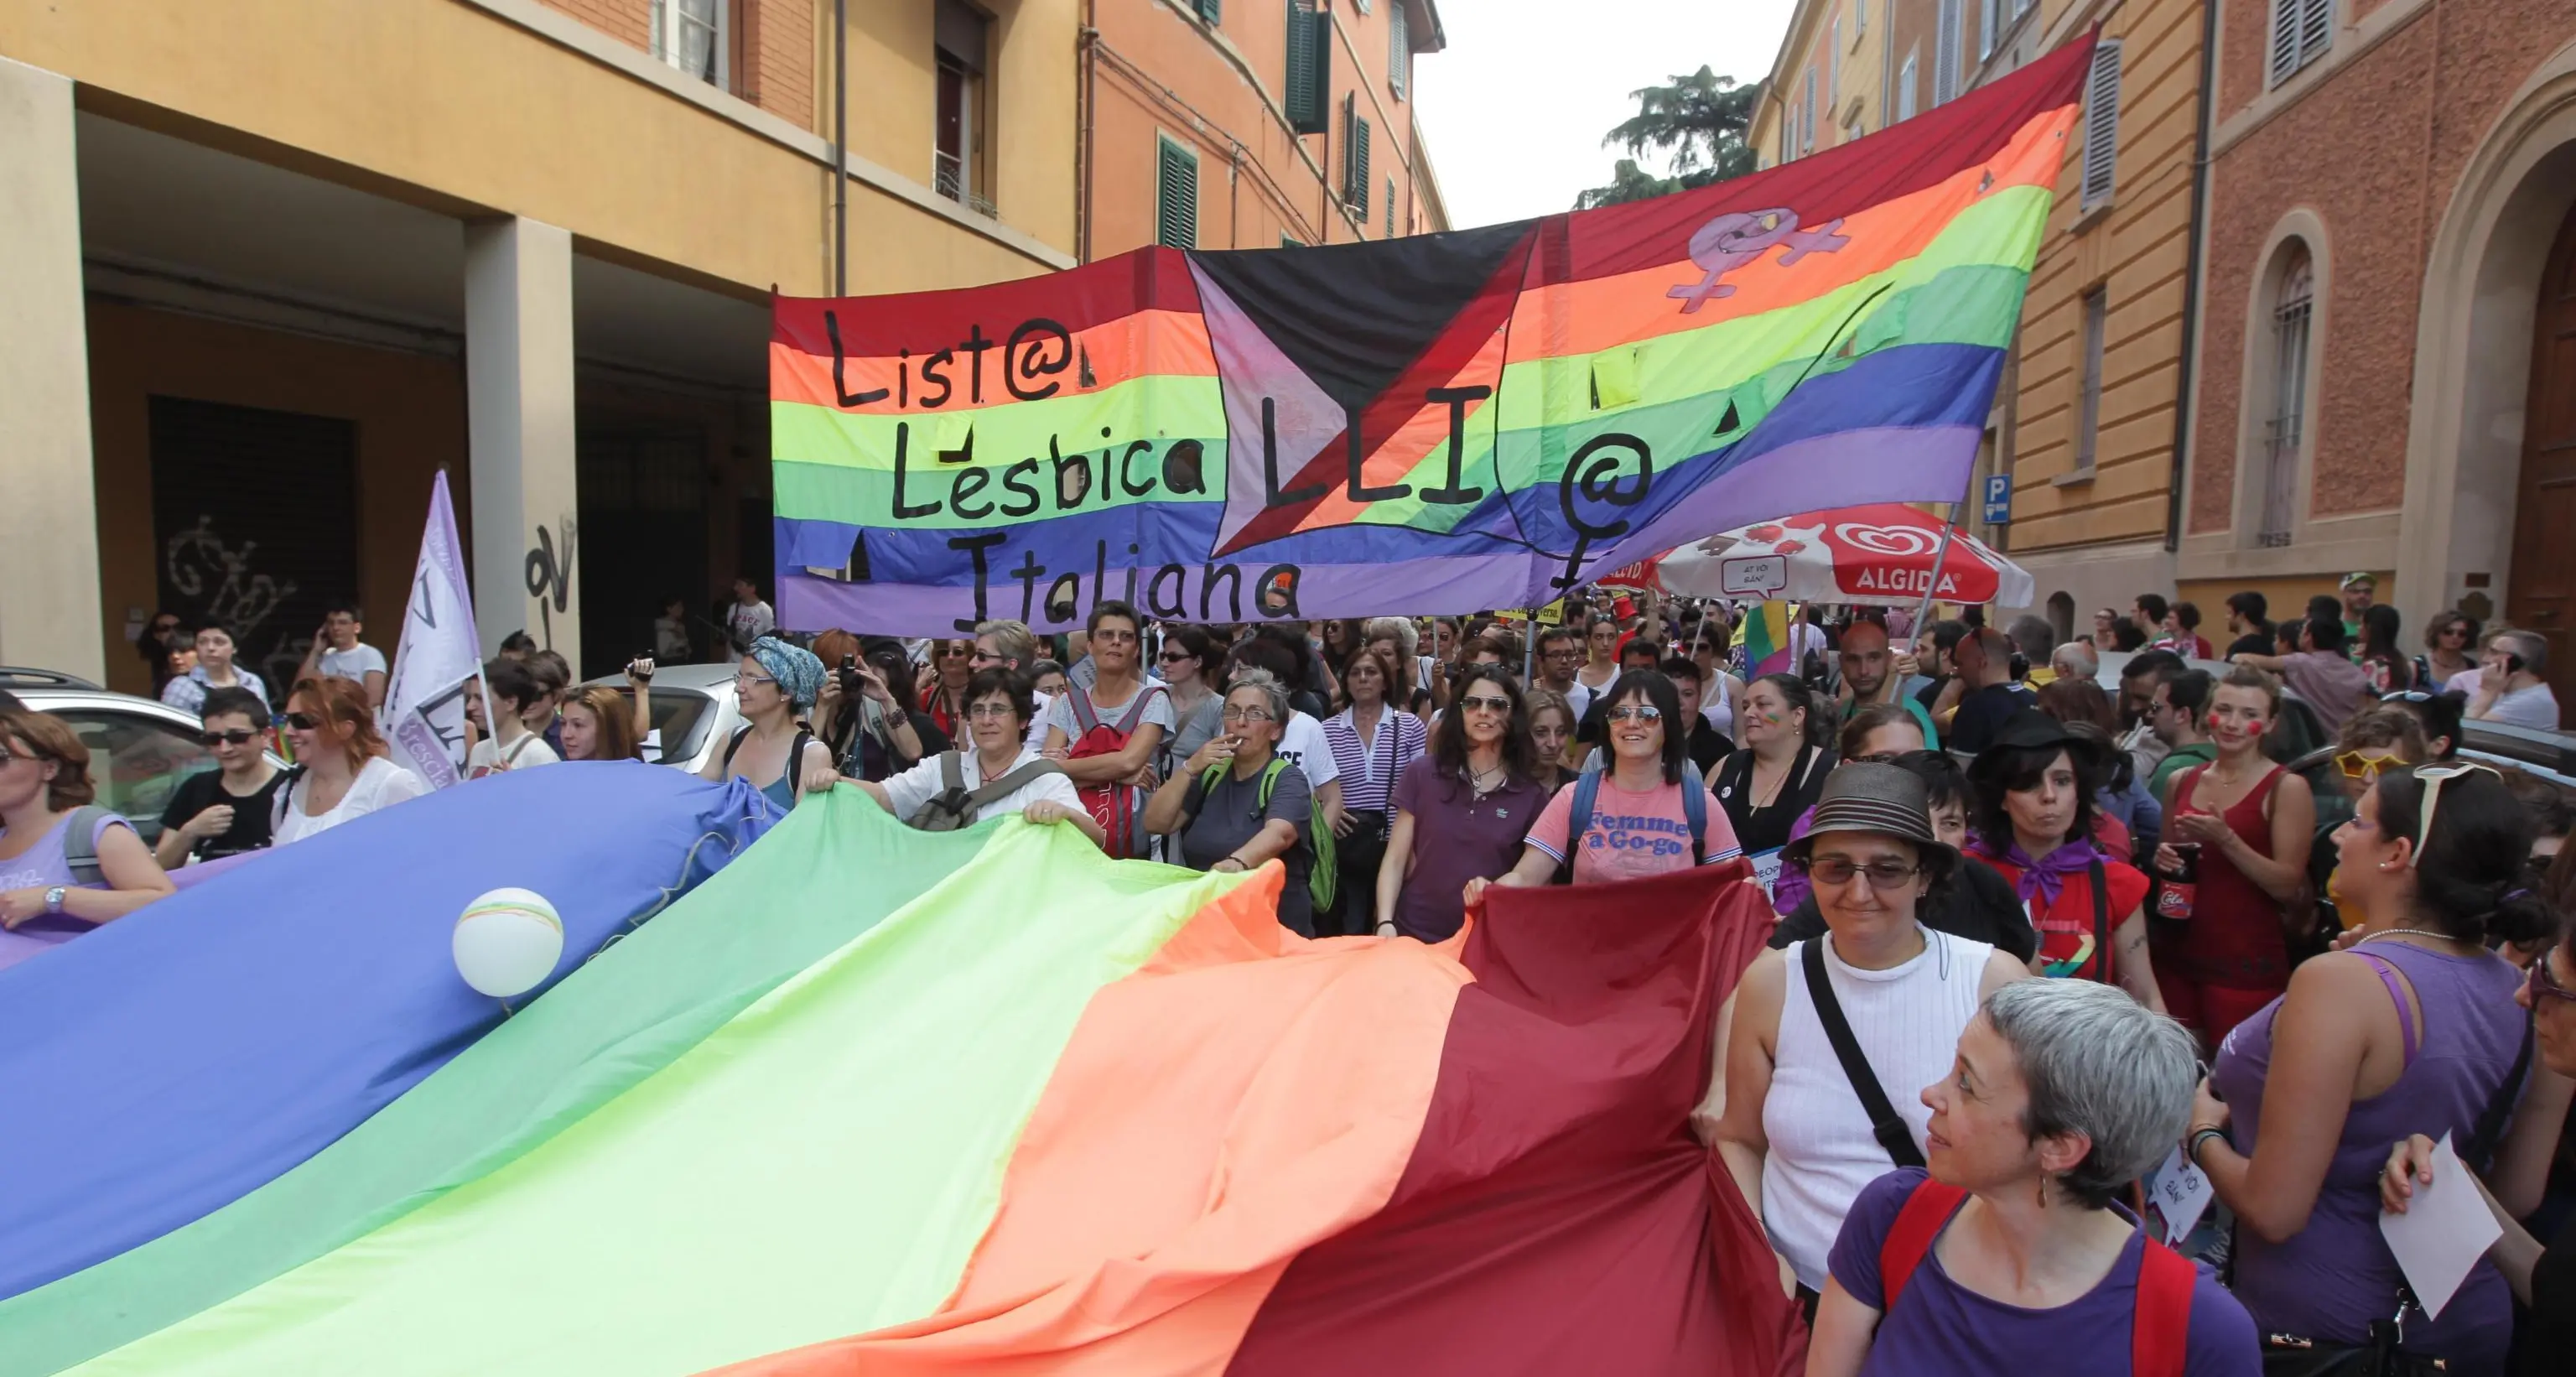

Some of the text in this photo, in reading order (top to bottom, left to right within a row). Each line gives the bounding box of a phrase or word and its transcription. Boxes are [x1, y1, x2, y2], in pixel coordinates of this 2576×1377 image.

[823, 310, 1072, 408] List@
[891, 422, 1208, 520] Lesbica
[1261, 384, 1491, 507] LLI
[1991, 478, 2005, 501] P
[947, 532, 1302, 633] Italiana
[1587, 812, 1689, 837] Femme
[1590, 830, 1683, 856] a Go-go
